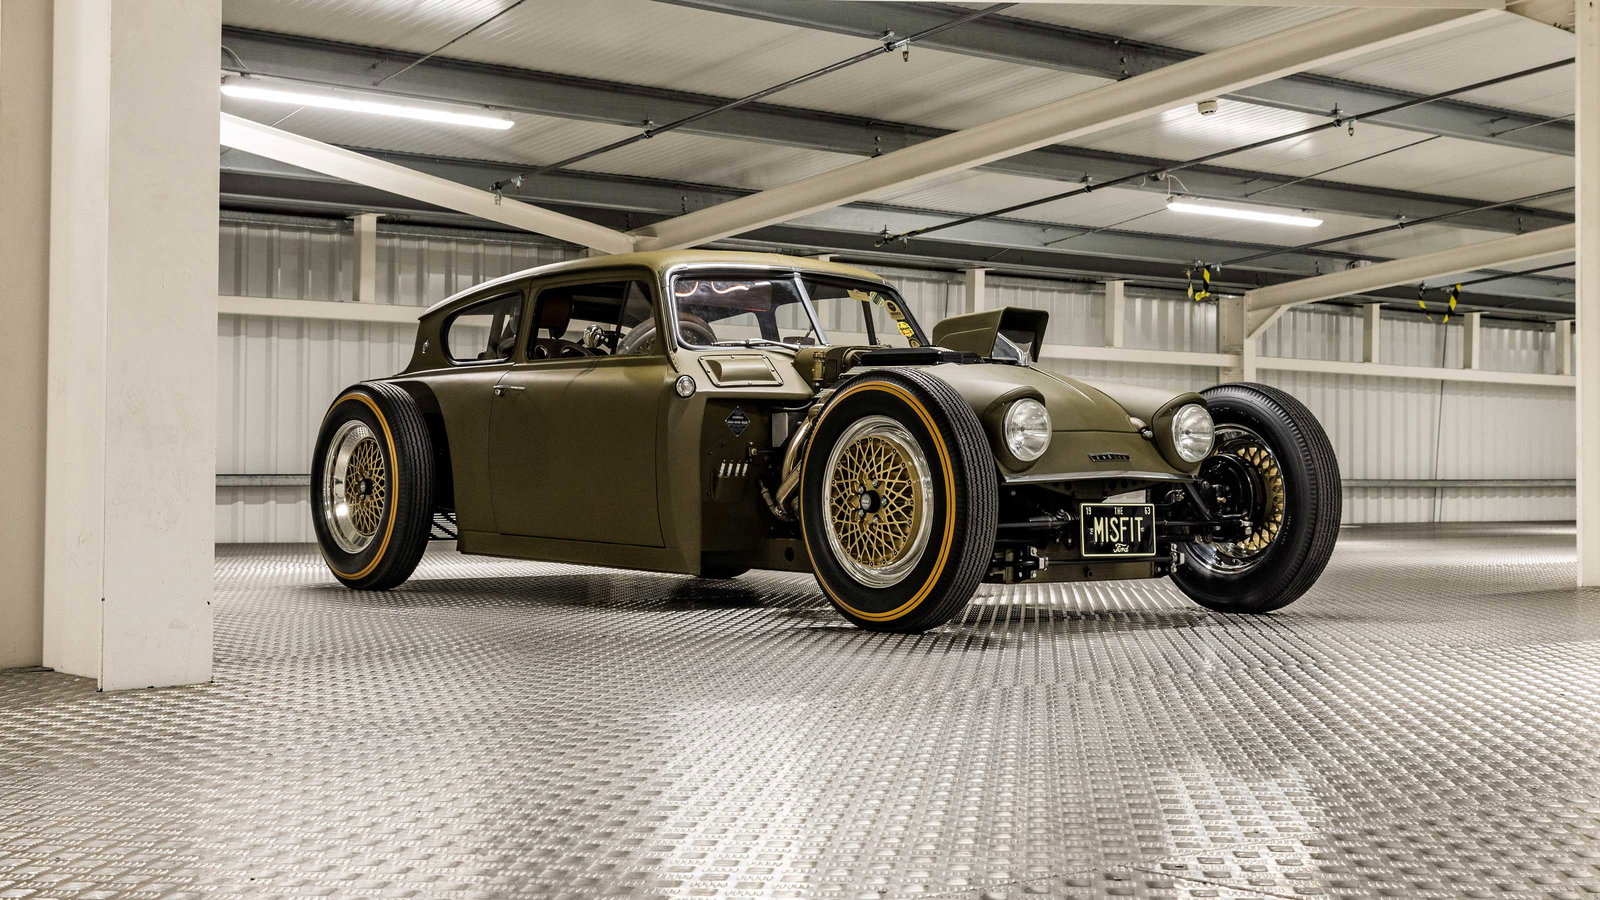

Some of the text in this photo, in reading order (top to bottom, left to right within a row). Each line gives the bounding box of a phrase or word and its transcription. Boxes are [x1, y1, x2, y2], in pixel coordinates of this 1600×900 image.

[1114, 507, 1124, 515] THE
[1094, 517, 1143, 542] MISFIT
[1113, 543, 1129, 553] Ford
